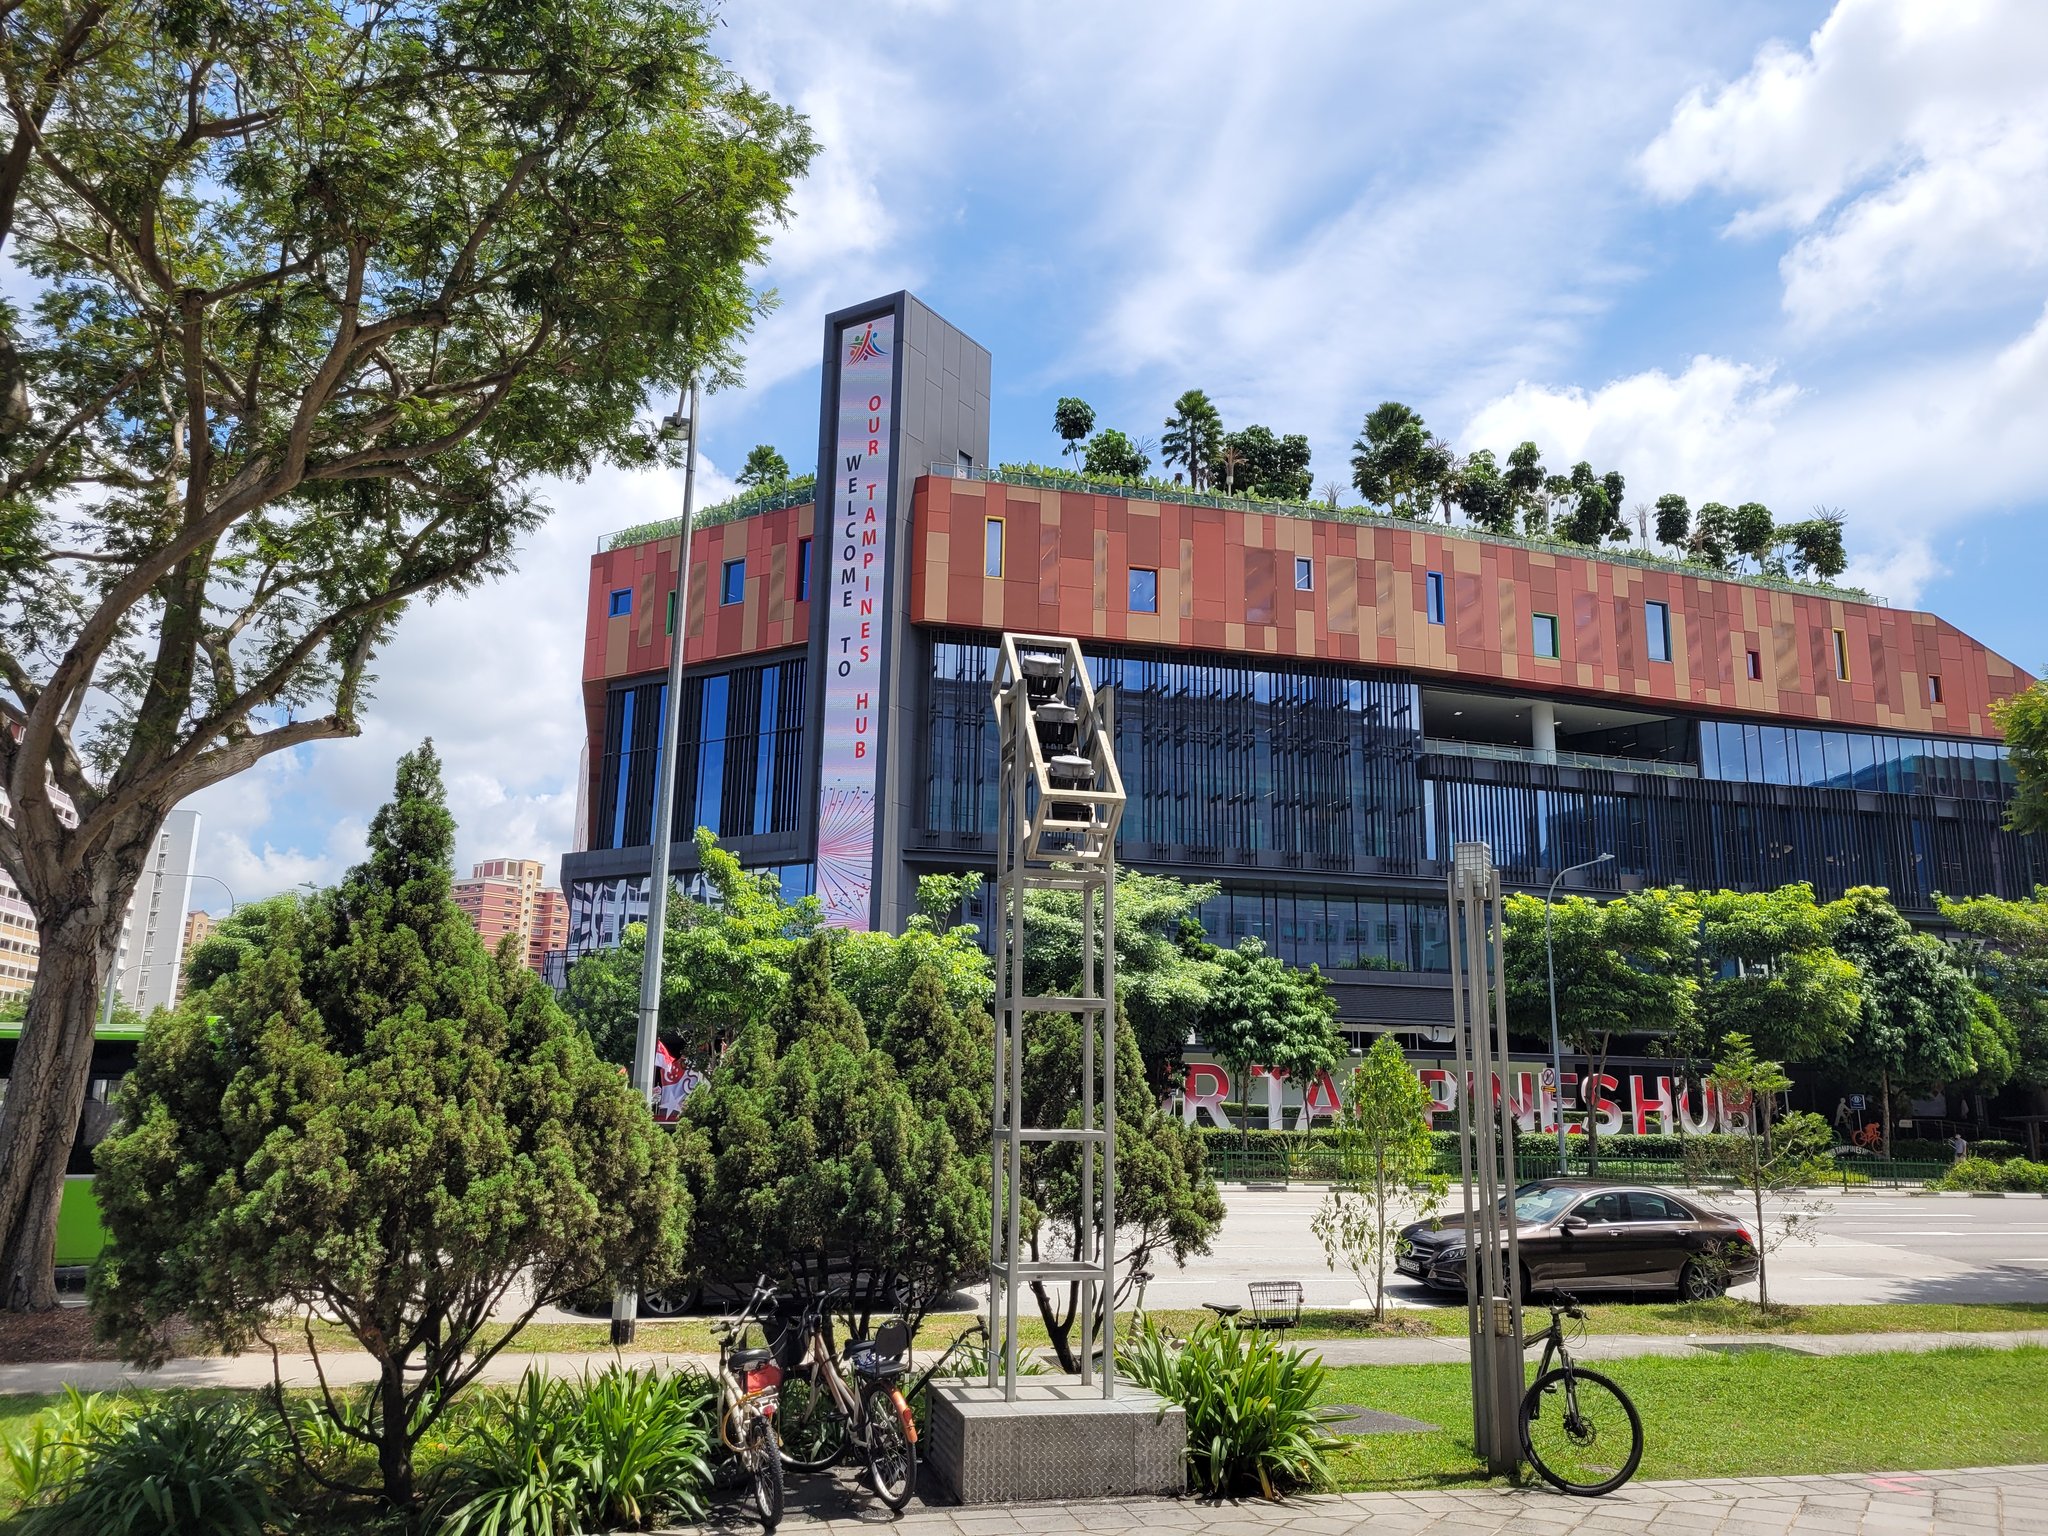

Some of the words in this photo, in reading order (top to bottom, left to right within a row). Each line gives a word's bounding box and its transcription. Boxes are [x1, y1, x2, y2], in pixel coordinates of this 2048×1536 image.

[868, 395, 882, 456] OUR
[841, 453, 862, 608] WELCOME
[860, 483, 877, 663] TAMPINES
[838, 636, 851, 678] TO
[855, 692, 869, 759] HUB
